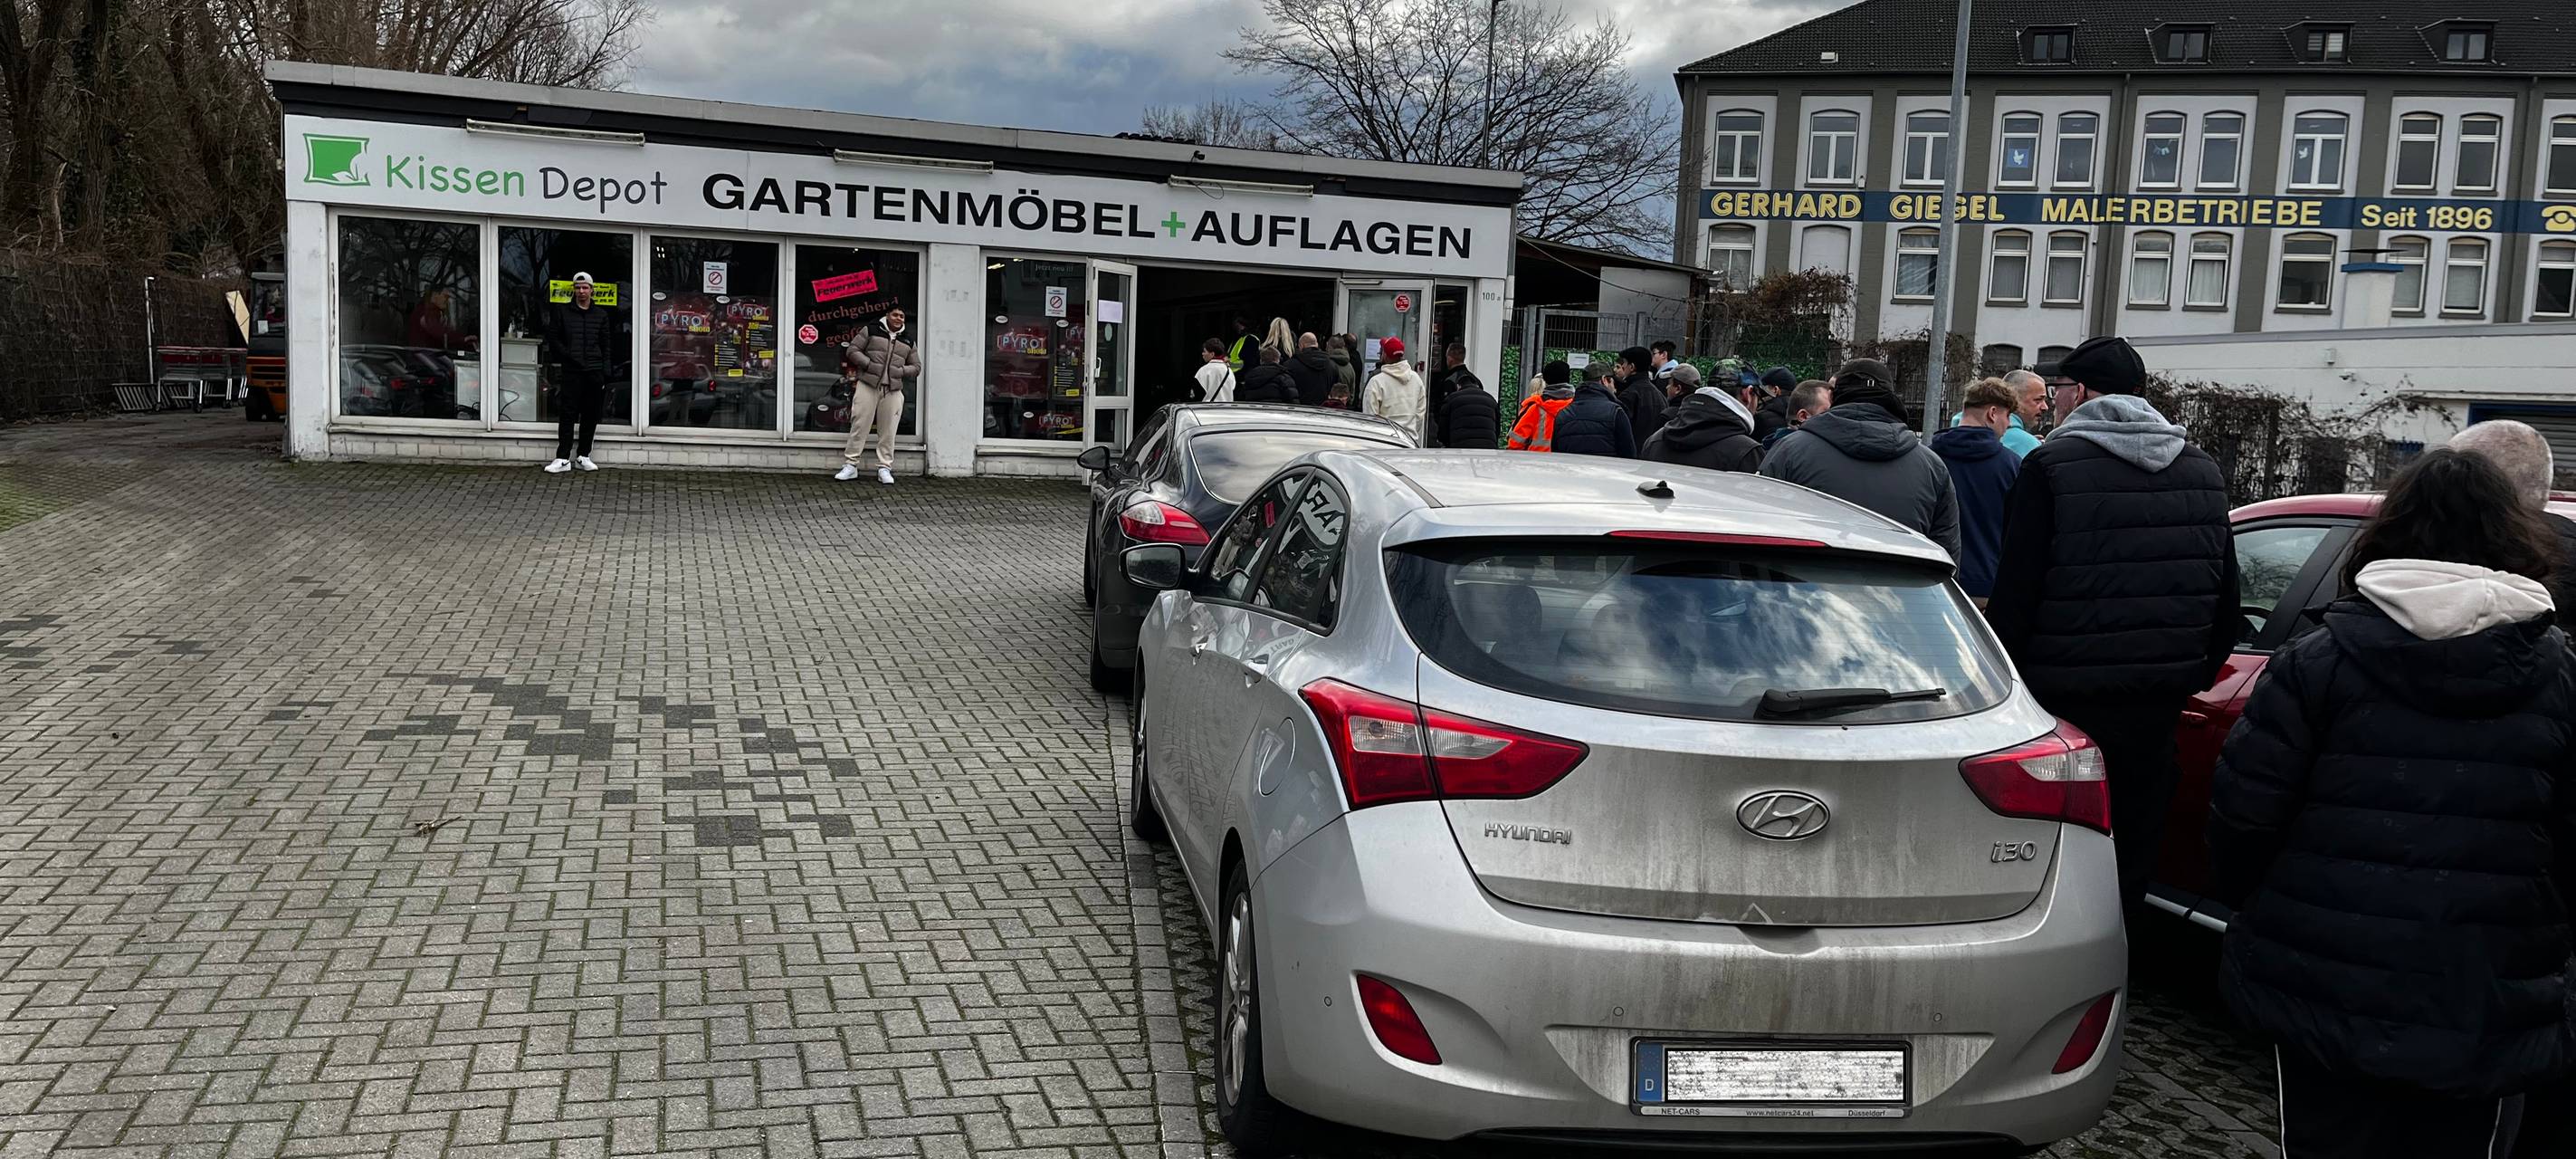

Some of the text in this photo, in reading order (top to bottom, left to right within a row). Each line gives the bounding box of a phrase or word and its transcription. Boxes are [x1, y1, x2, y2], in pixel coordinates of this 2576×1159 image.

[386, 155, 668, 215] Kissen Depot
[1711, 191, 1862, 220] GERHARD
[2042, 197, 2323, 225] MALERBETRIEBE
[2361, 205, 2417, 229] Seit
[2427, 206, 2494, 230] 1896
[1482, 292, 1495, 301] 100
[731, 305, 762, 317] PYRO
[661, 313, 701, 327] PYRO
[1002, 336, 1039, 349] PYRO
[1484, 822, 1572, 845] HYUNDAI
[1991, 840, 2037, 863] i30
[1645, 1078, 1655, 1092] D
